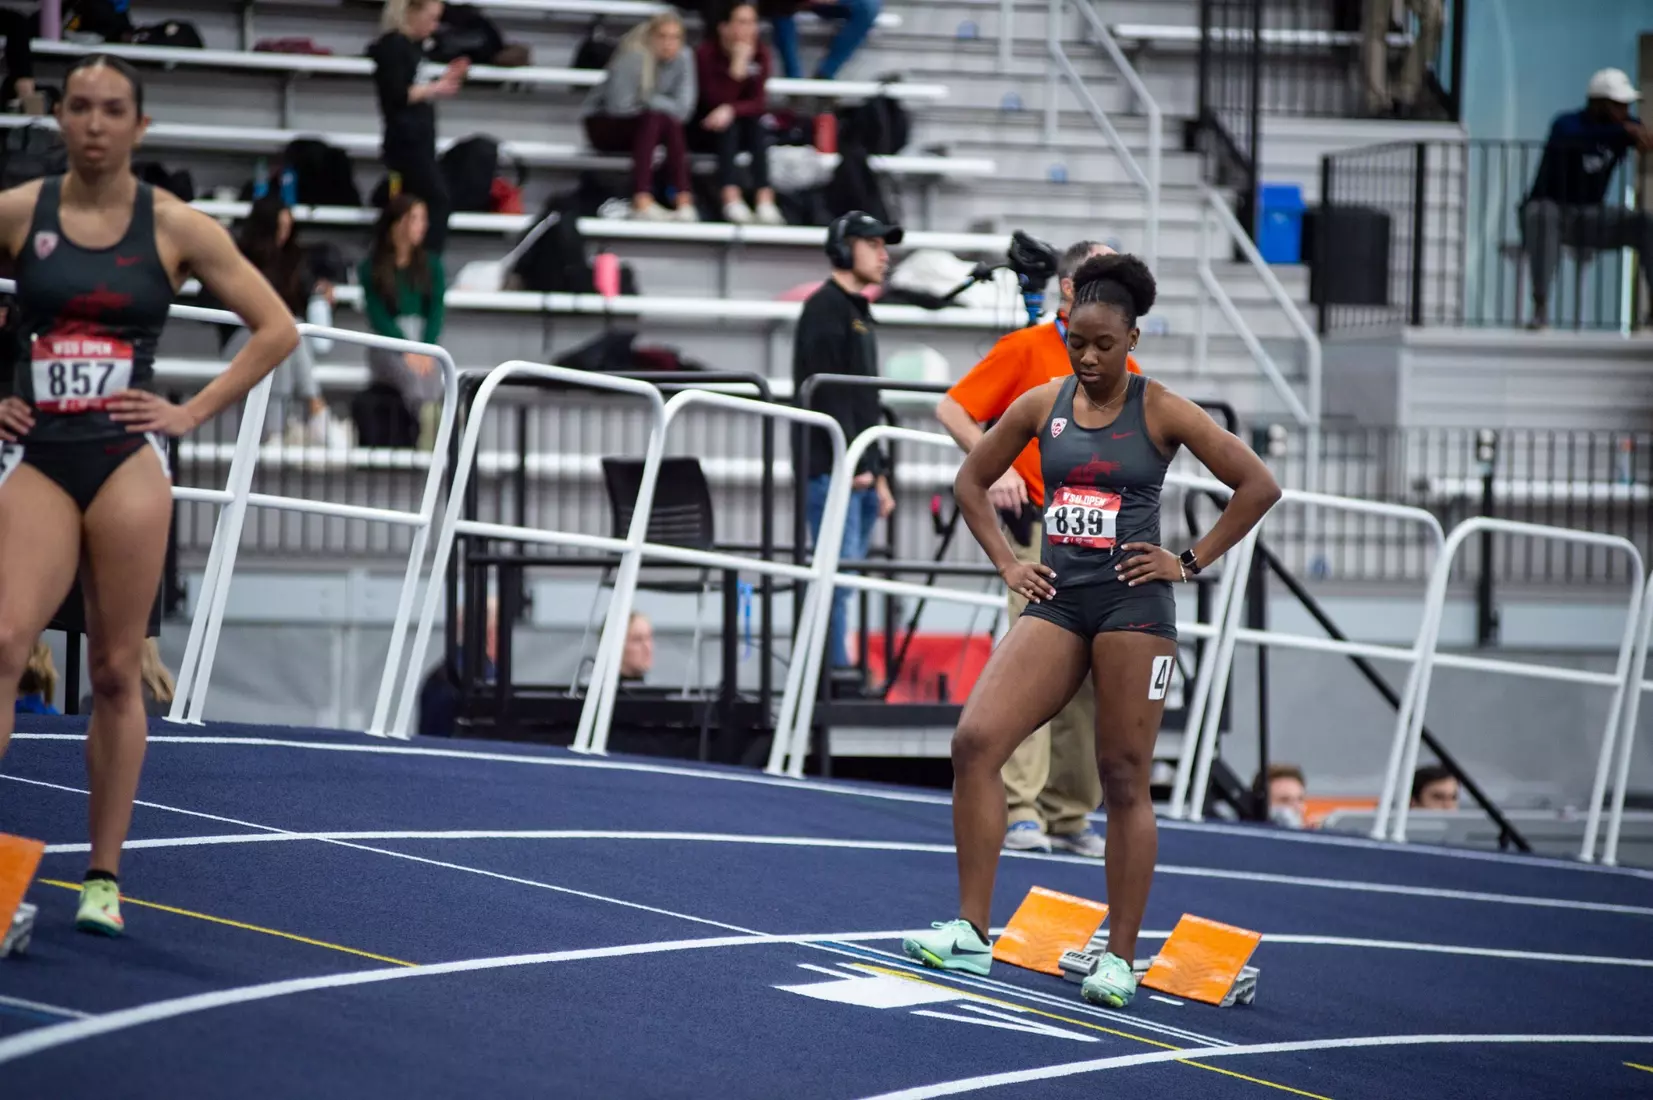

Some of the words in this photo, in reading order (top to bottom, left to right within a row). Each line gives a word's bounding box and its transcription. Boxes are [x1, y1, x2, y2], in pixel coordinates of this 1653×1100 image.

[48, 361, 115, 396] 857
[1083, 495, 1107, 507] OPEN
[1055, 506, 1103, 536] 839
[1154, 659, 1168, 697] 4
